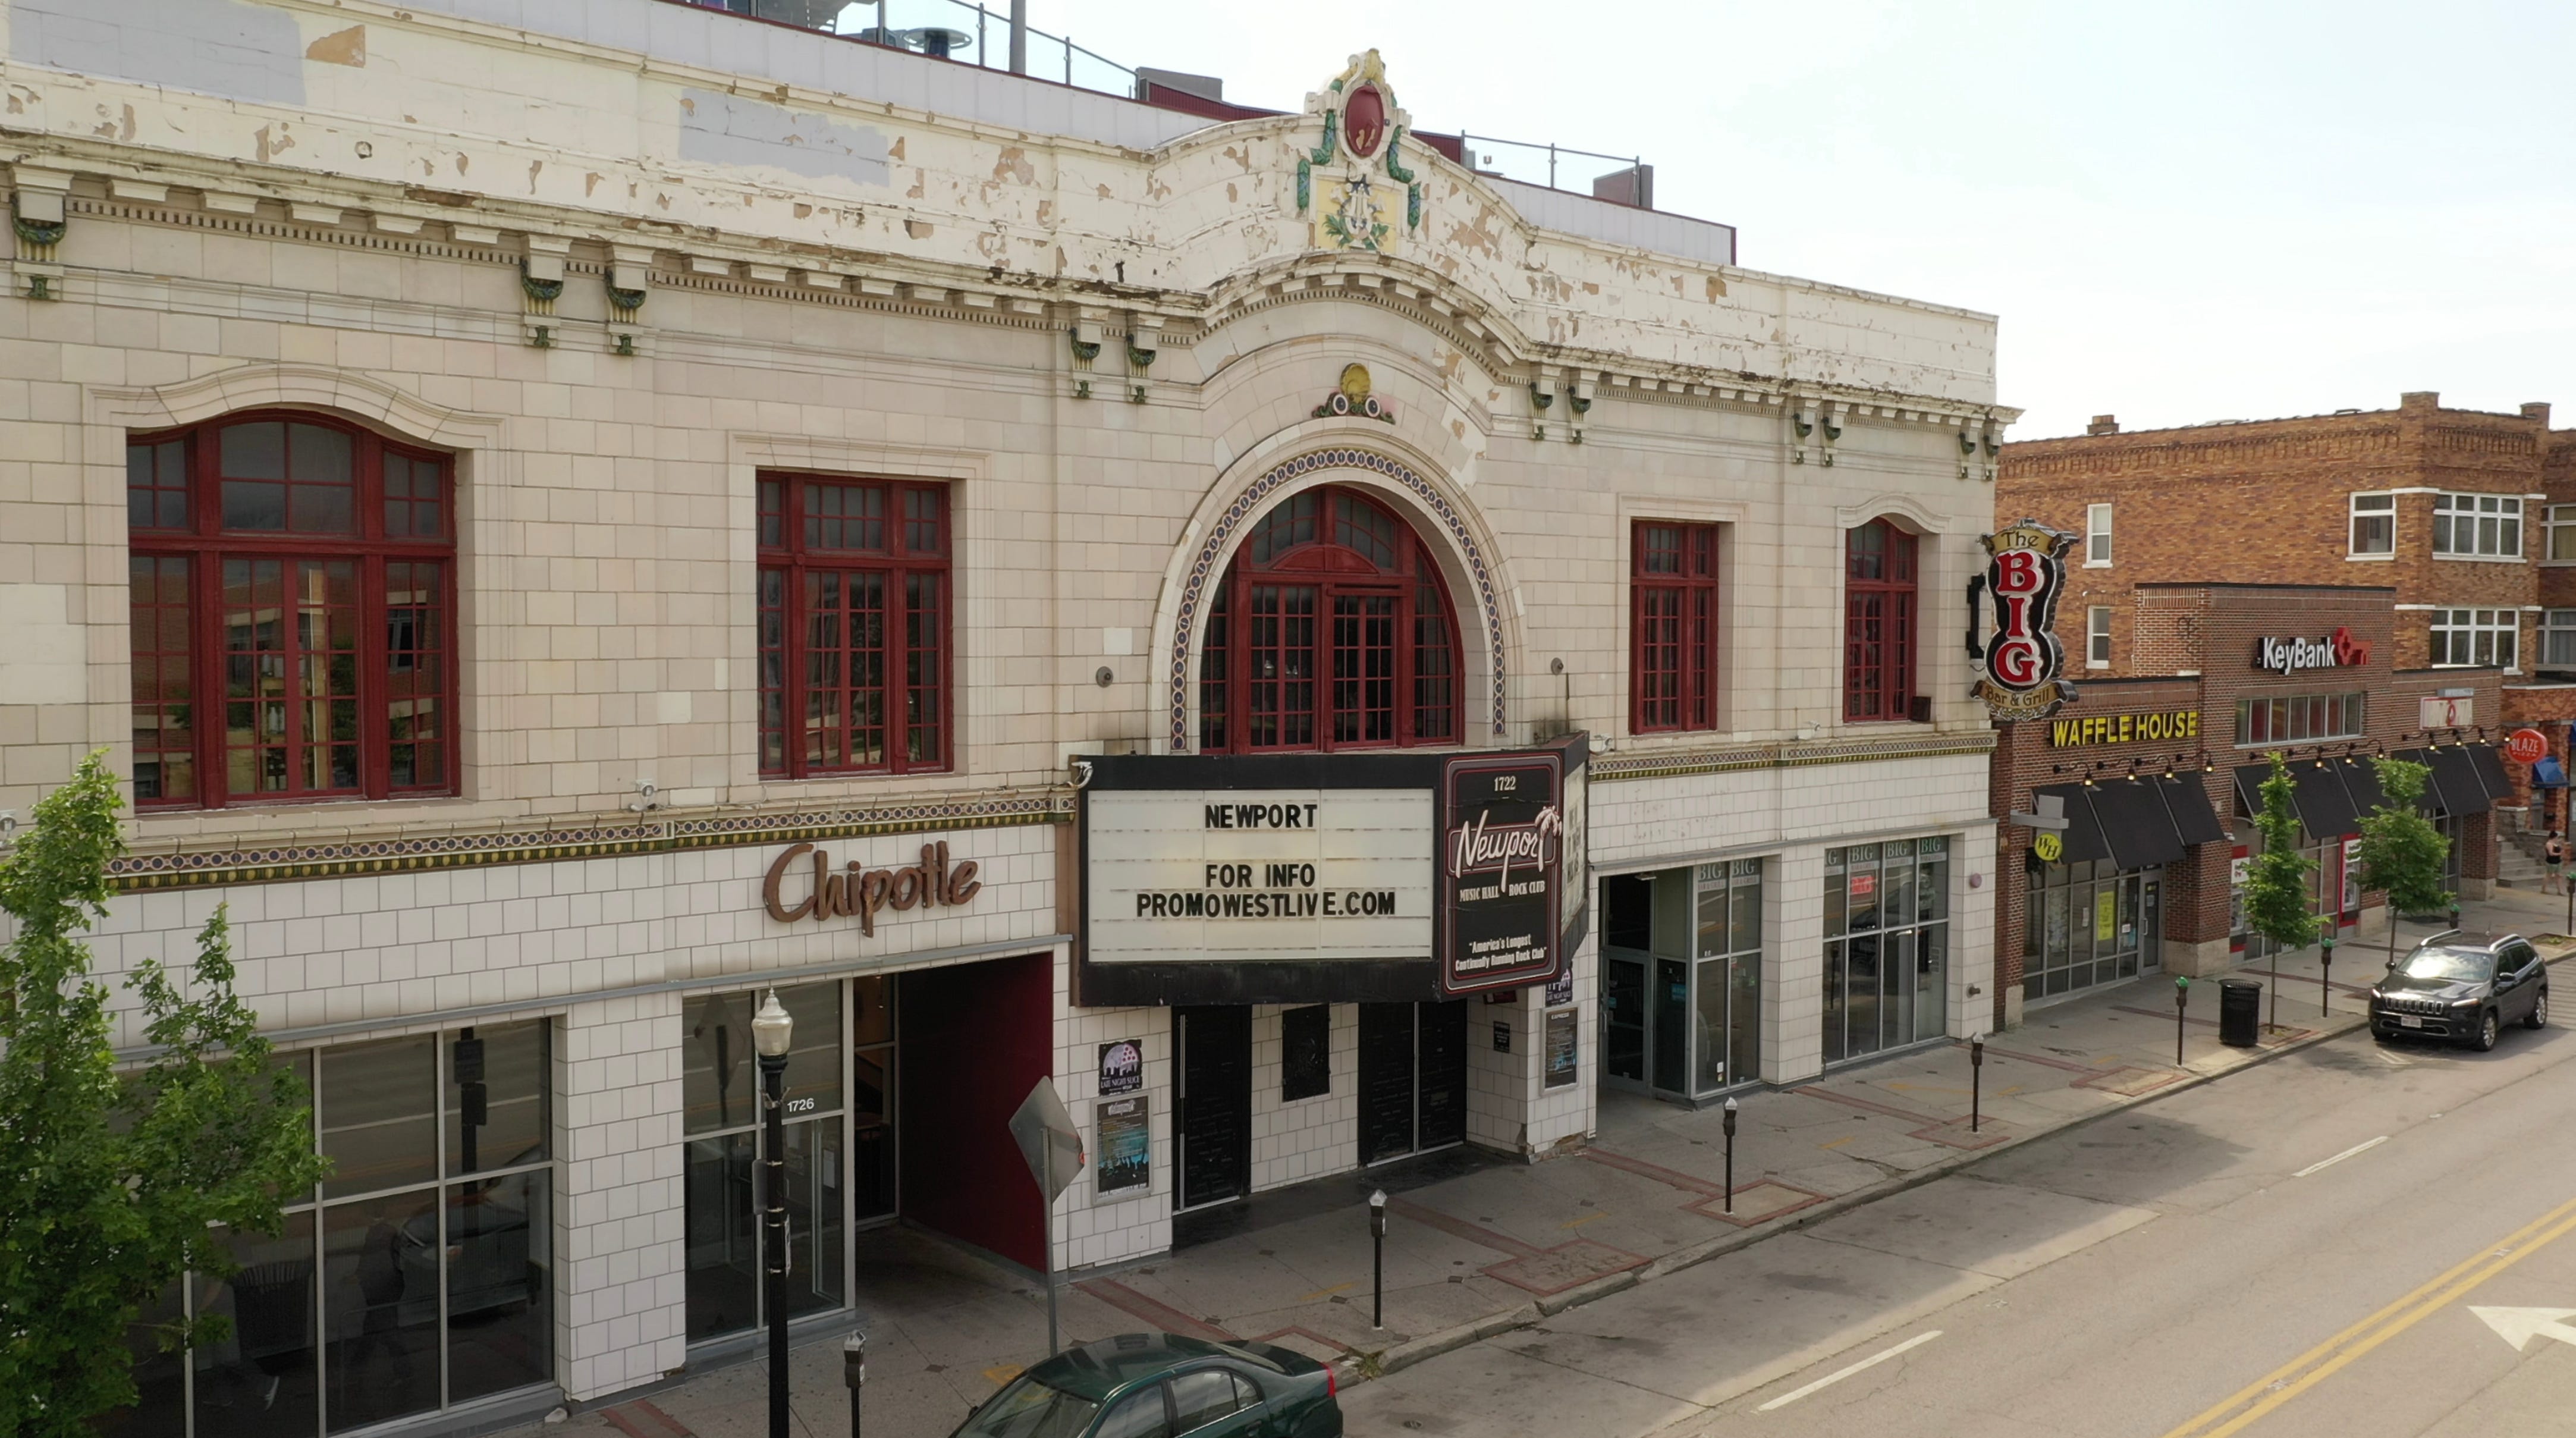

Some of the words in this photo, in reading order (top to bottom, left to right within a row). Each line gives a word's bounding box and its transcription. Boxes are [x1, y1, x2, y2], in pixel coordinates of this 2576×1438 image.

[2000, 530, 2039, 548] The
[1996, 551, 2041, 683] BIG
[2263, 636, 2336, 676] KeyBank
[1986, 686, 2008, 704] Bar
[2010, 693, 2019, 707] &
[2023, 688, 2049, 707] Grill
[2053, 715, 2130, 748] WAFFLE
[2136, 711, 2198, 740] HOUSE
[2511, 737, 2539, 752] BLAZE
[1494, 775, 1516, 792] 1722
[1205, 804, 1318, 828] NEWPORT
[1456, 806, 1560, 892] Newport
[1852, 845, 1873, 862] BIG
[1887, 841, 1907, 857] BIG
[1921, 837, 1940, 853] BIG
[1205, 864, 1252, 888] FOR
[1265, 863, 1315, 888] INFO
[1698, 862, 1722, 880] BIG
[1731, 859, 1755, 875] BIG
[763, 840, 982, 938] Chipotle
[1459, 888, 1480, 902] MUSIC
[1482, 886, 1499, 899] HALL
[1509, 883, 1528, 896] ROCK
[1529, 881, 1545, 894] CLUB
[1136, 891, 1396, 918] PROMOWESTLIVE.COM
[1506, 934, 1531, 949] Longest
[1455, 956, 1490, 971] Continually
[1491, 953, 1515, 966] Running
[1516, 950, 1530, 962] Rock
[787, 1098, 814, 1112] 1726
